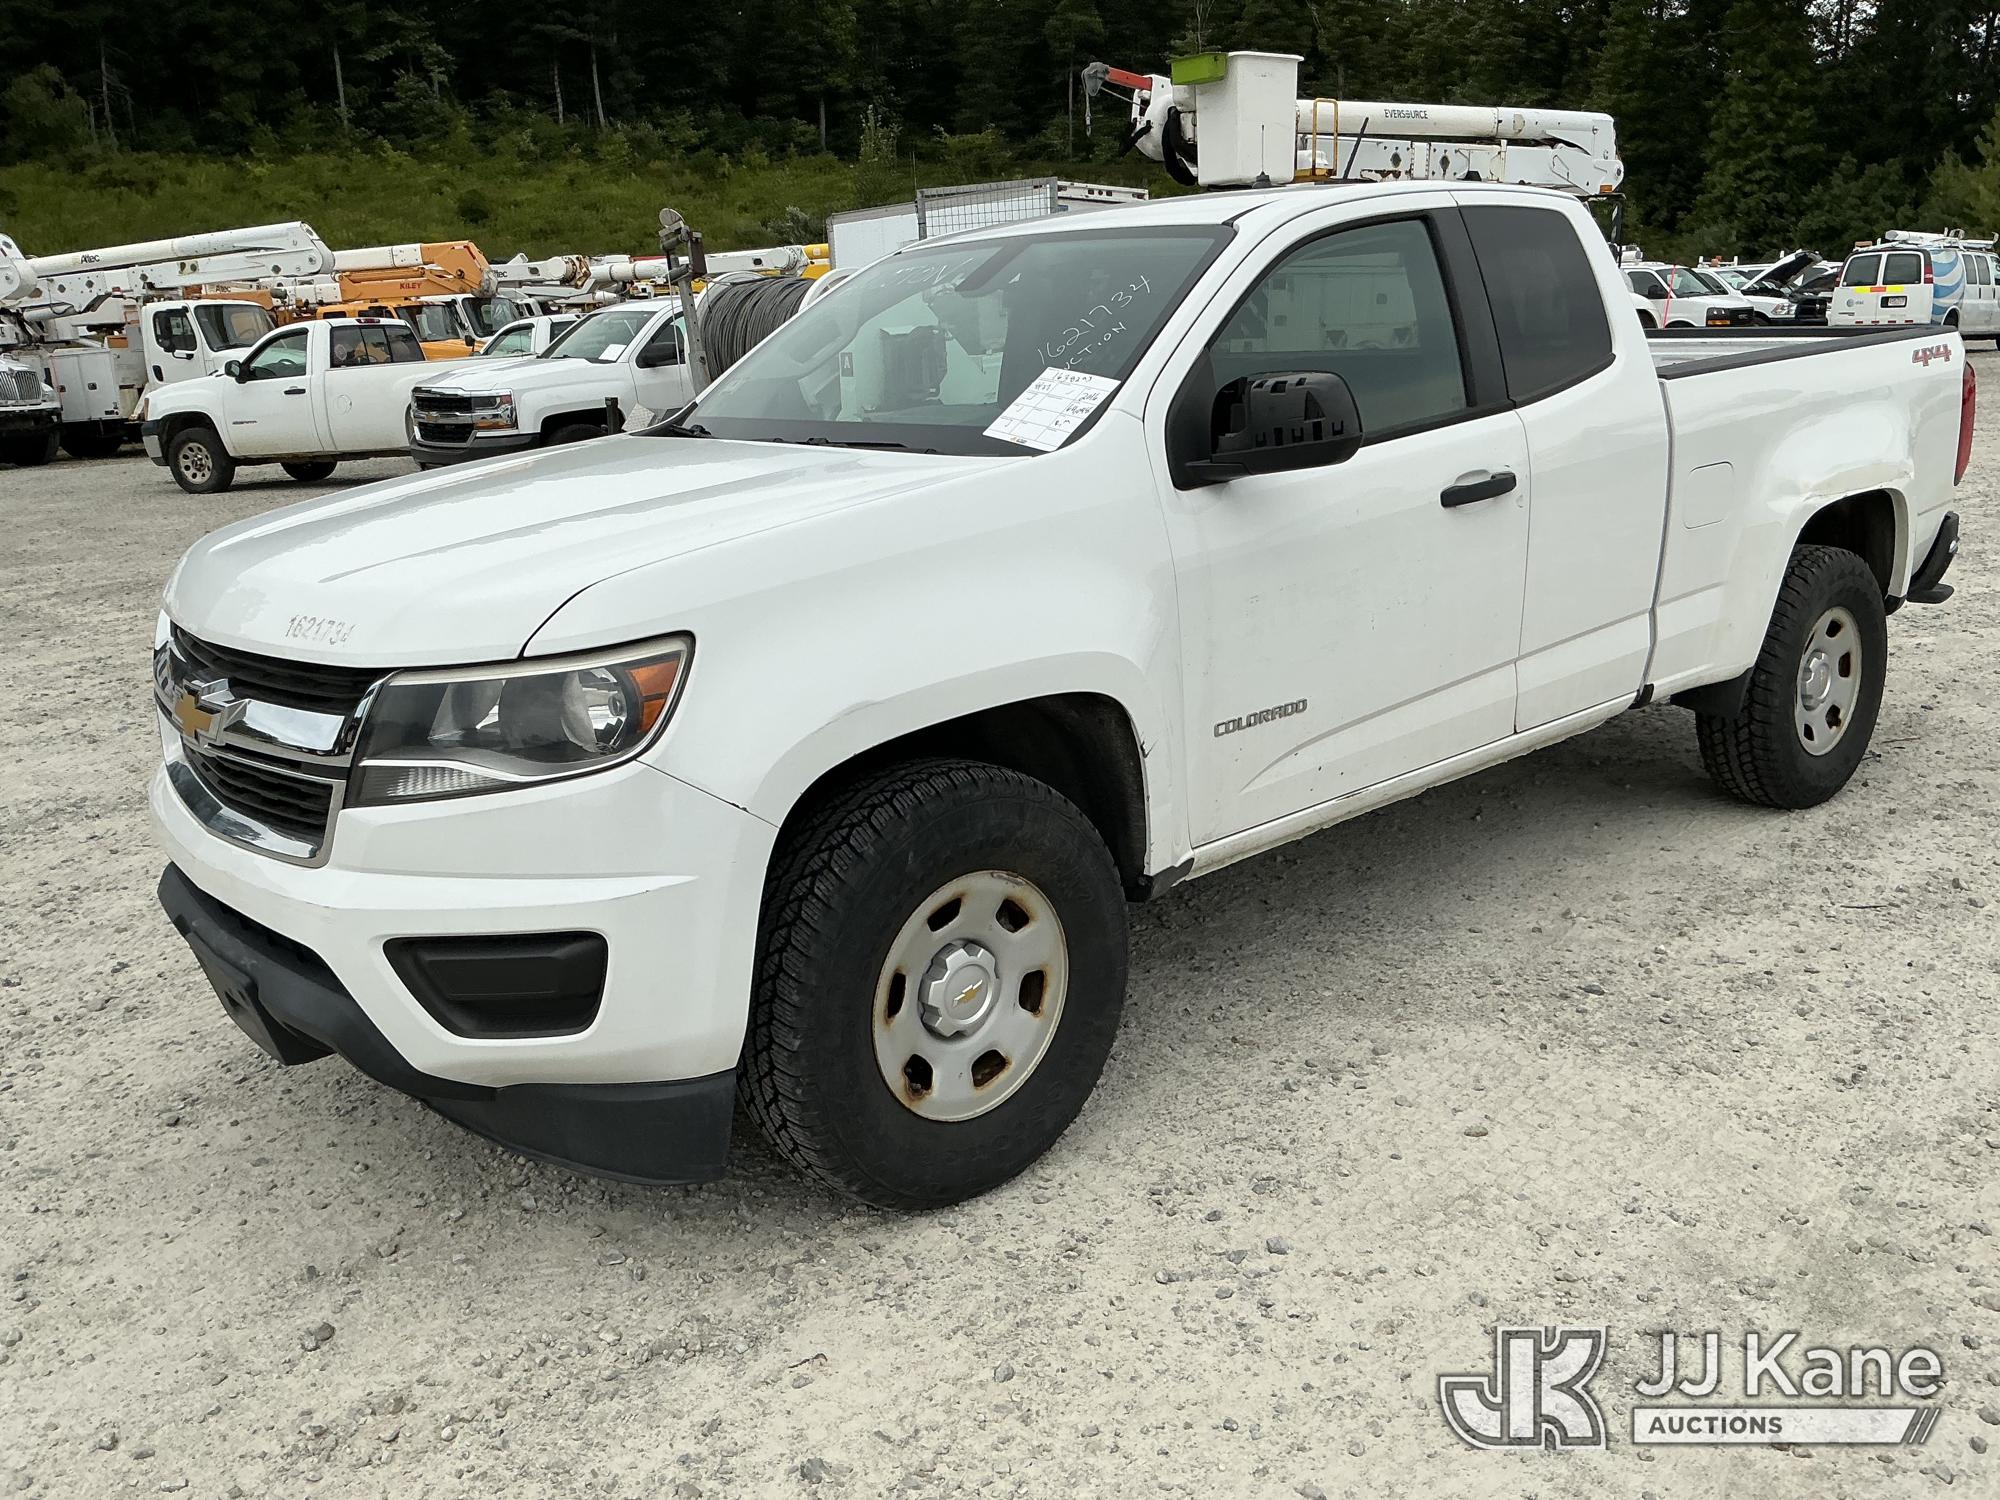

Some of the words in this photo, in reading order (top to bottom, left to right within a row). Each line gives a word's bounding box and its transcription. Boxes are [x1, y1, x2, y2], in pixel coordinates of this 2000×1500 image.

[1383, 108, 1428, 119] EVERSOURCE
[1037, 275, 1150, 365] 1621734
[1213, 698, 1308, 738] COLORADO
